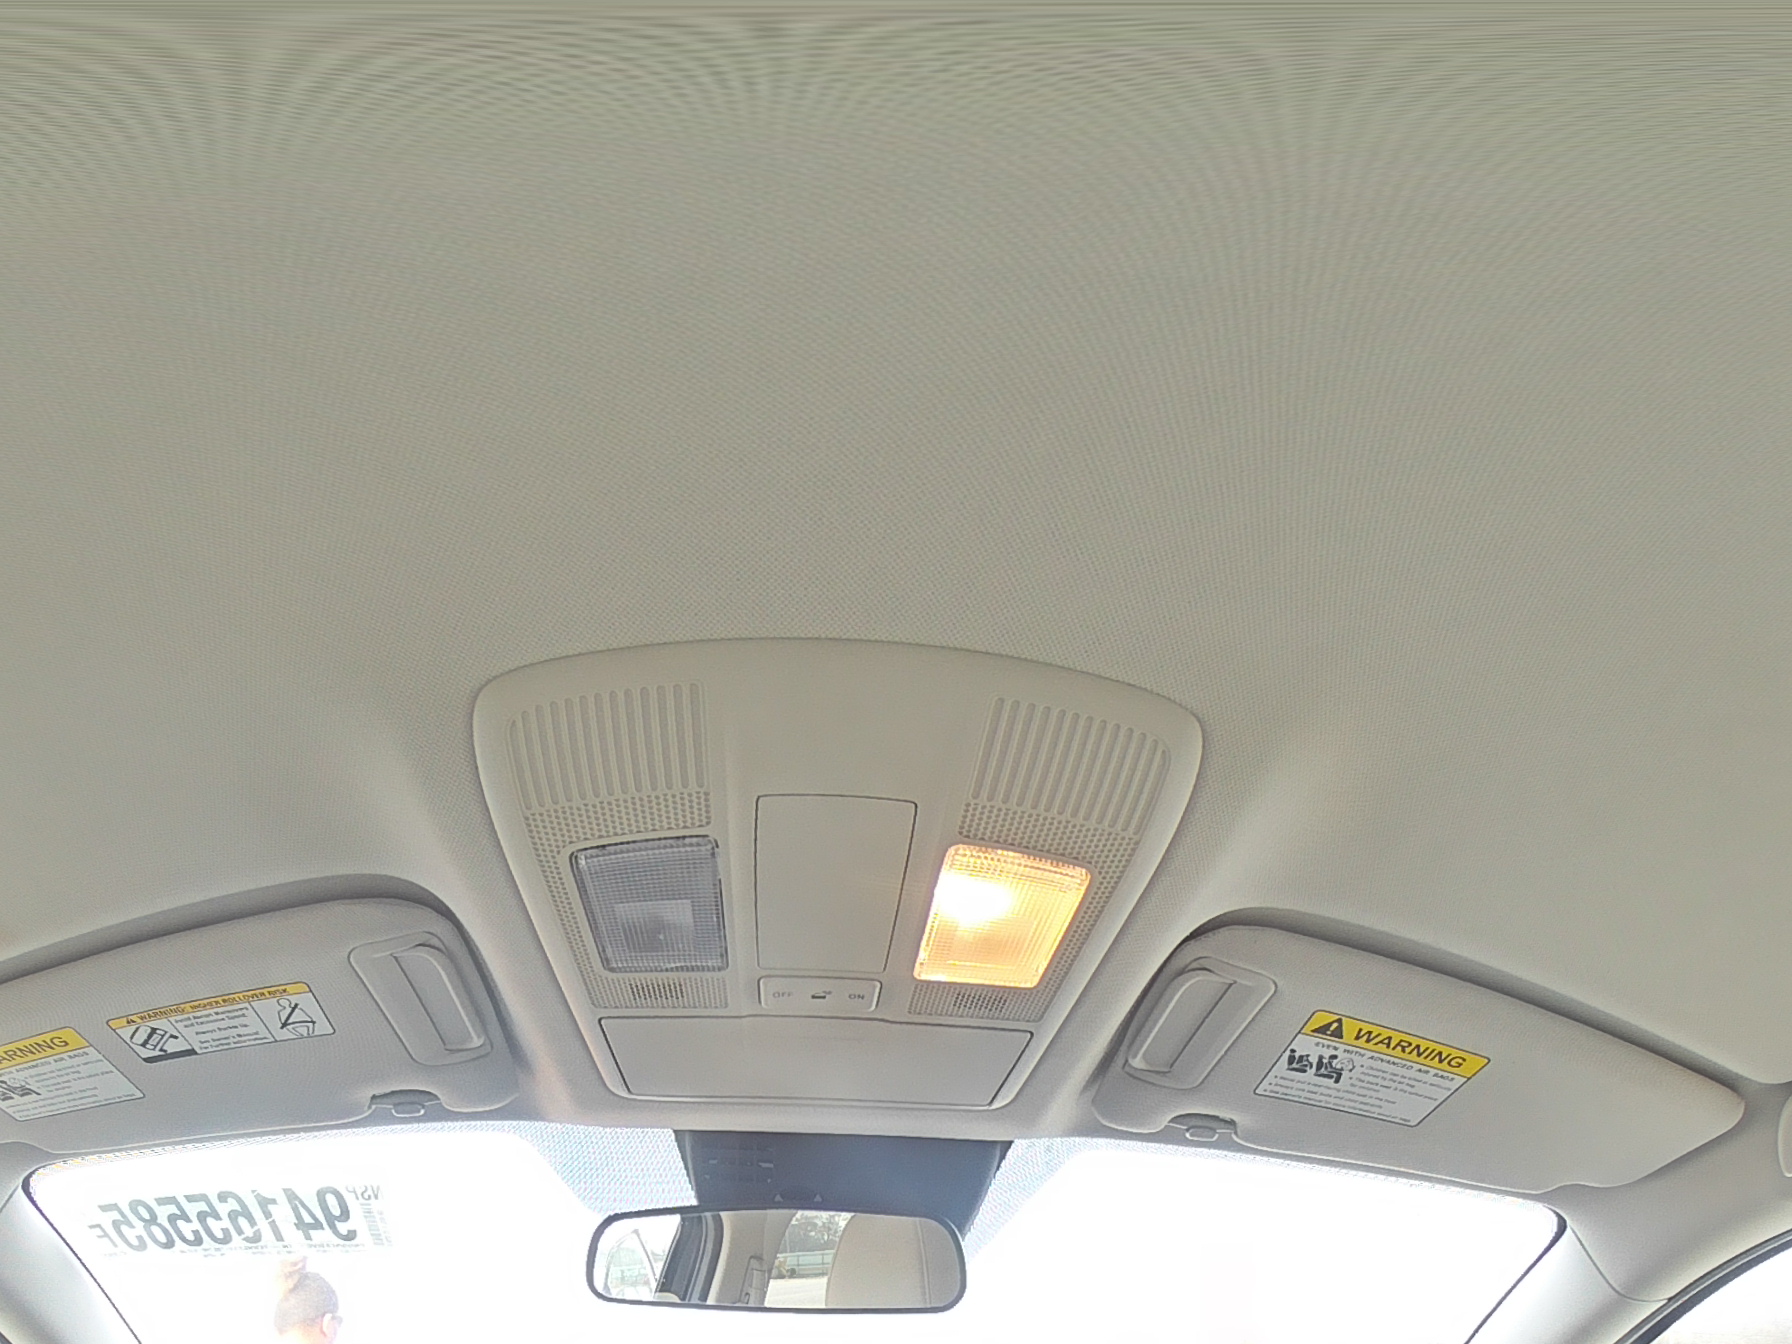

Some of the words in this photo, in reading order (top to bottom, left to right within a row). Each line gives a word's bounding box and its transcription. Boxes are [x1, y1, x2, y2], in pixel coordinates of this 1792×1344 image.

[1313, 1041, 1341, 1052] EVEN
[1343, 1048, 1367, 1058] WITH
[1353, 1027, 1467, 1070] WARNING
